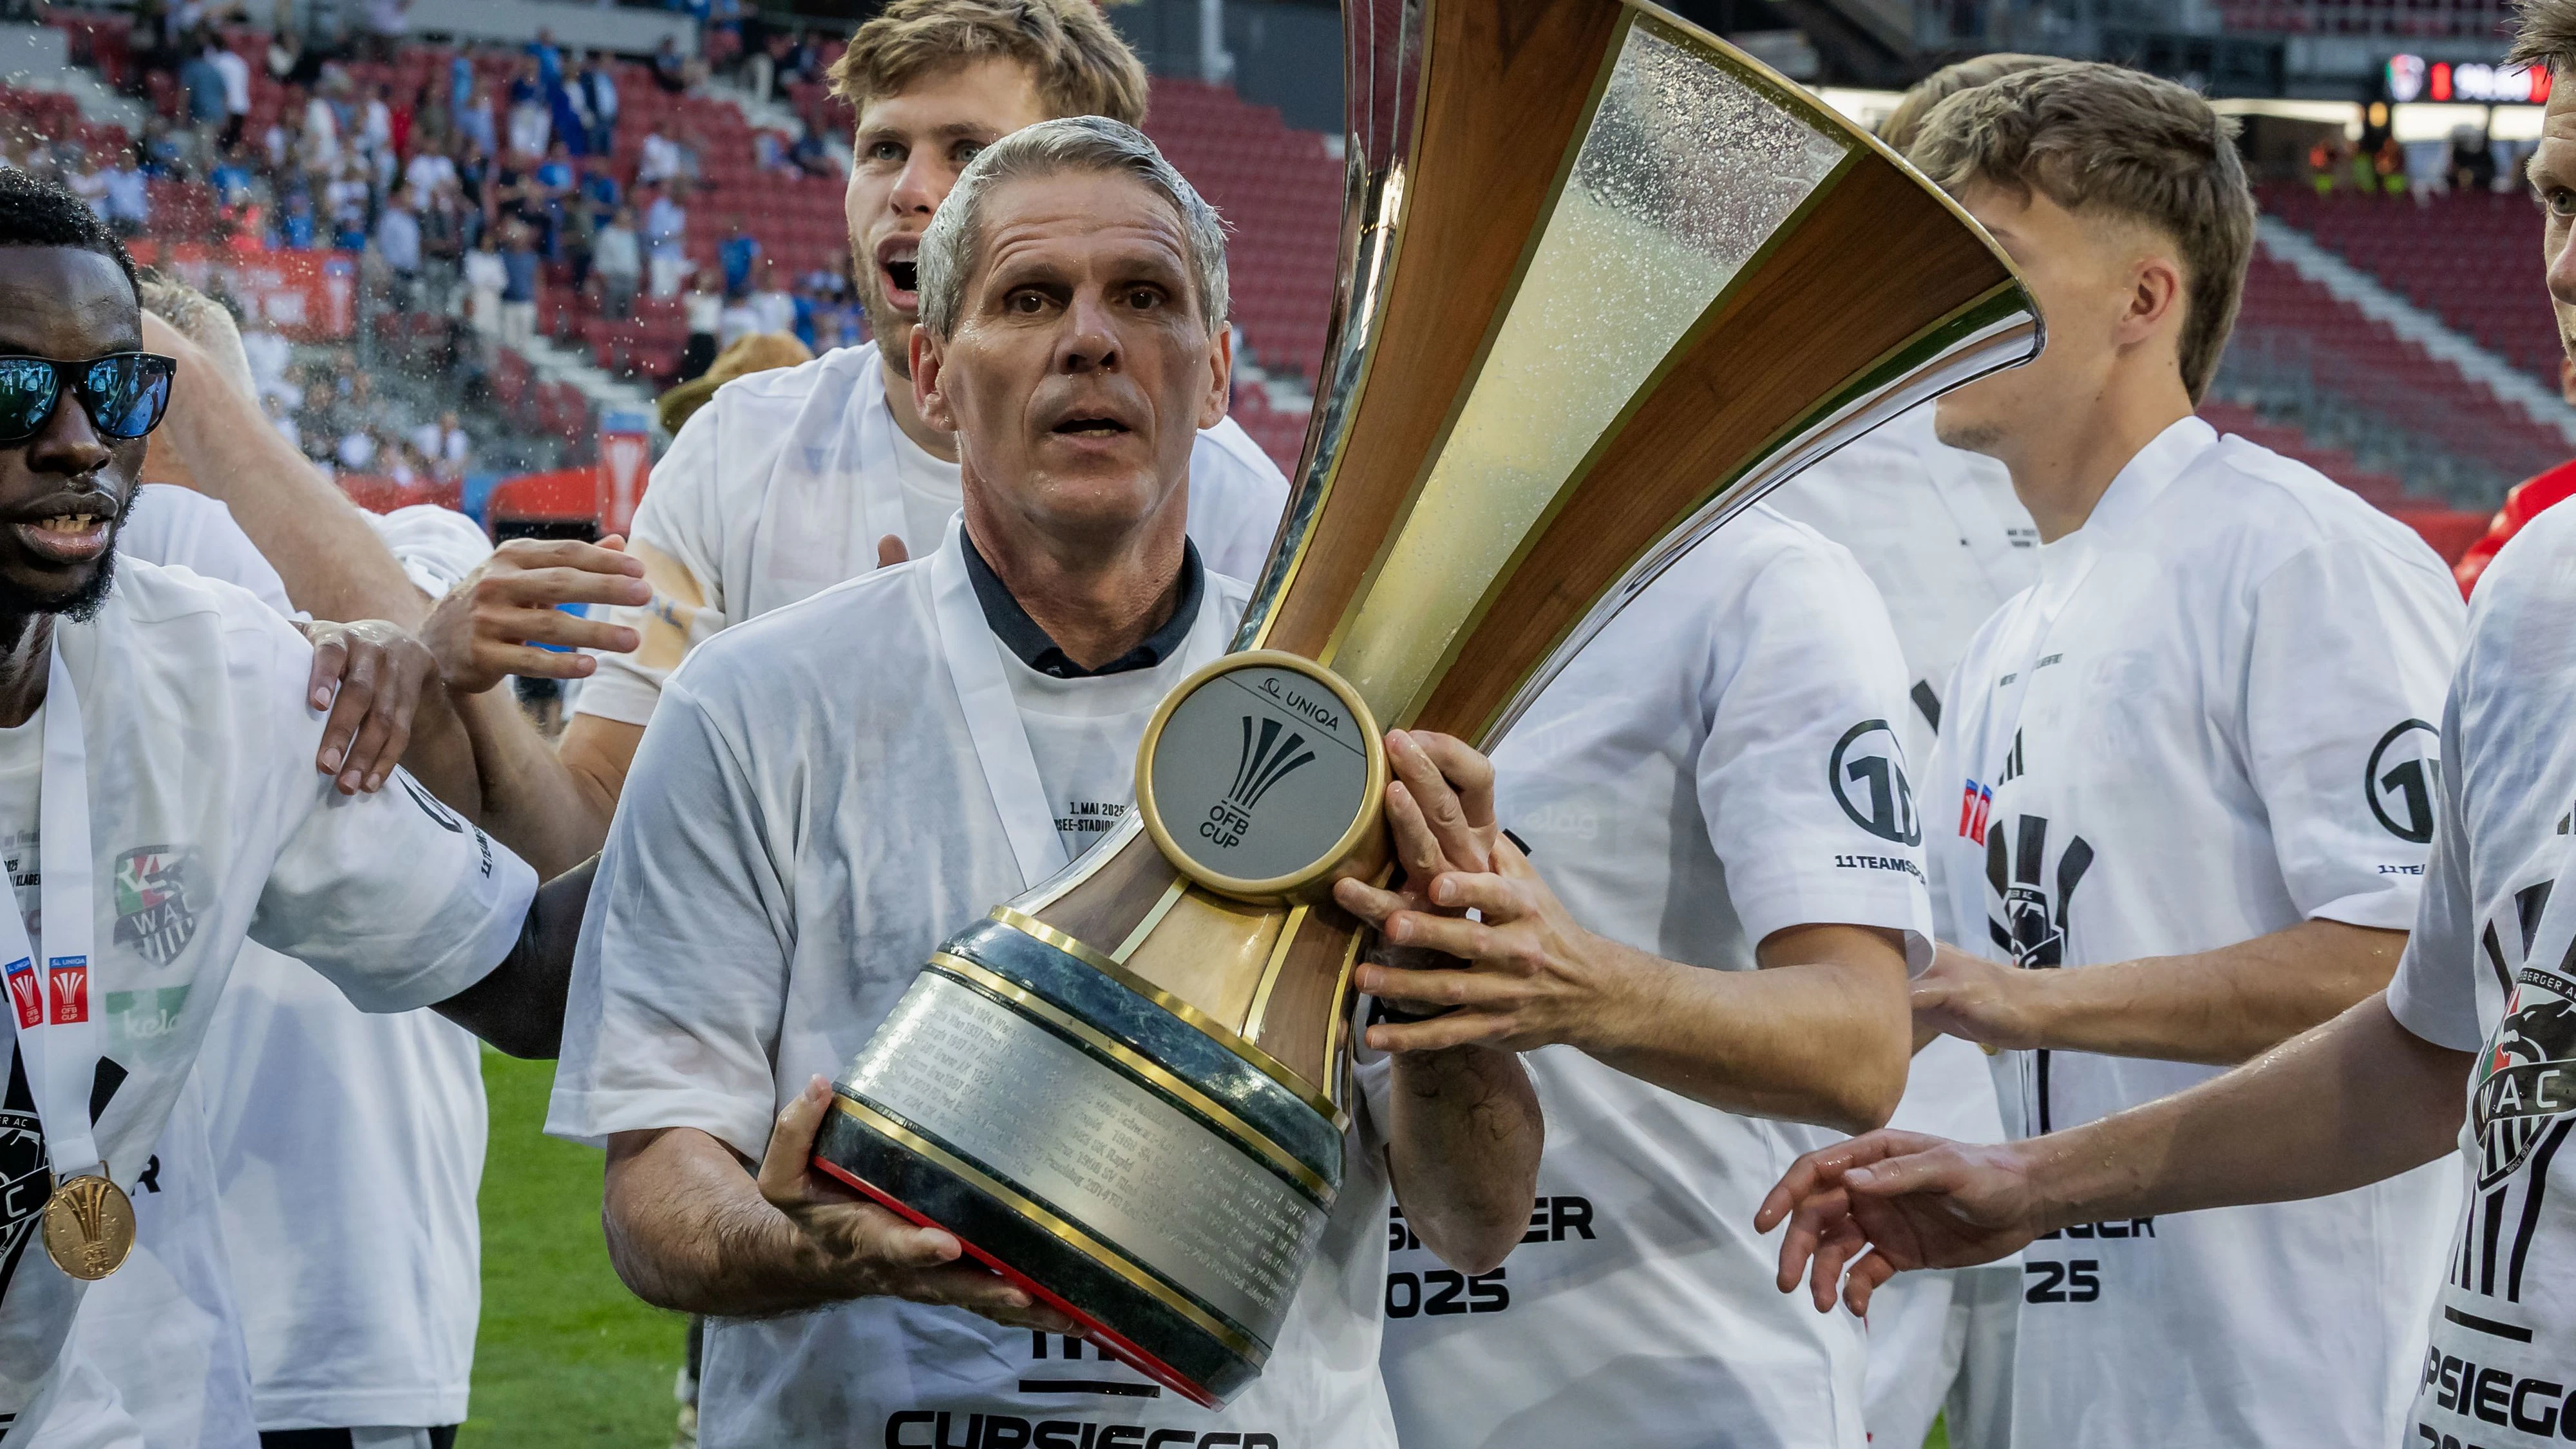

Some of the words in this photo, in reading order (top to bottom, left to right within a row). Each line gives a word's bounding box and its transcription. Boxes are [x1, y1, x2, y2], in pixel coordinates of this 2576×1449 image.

[1286, 690, 1340, 732] UNIQA
[1102, 804, 1125, 817] 2025
[1199, 821, 1240, 849] CUP
[2481, 1070, 2560, 1124] WAC
